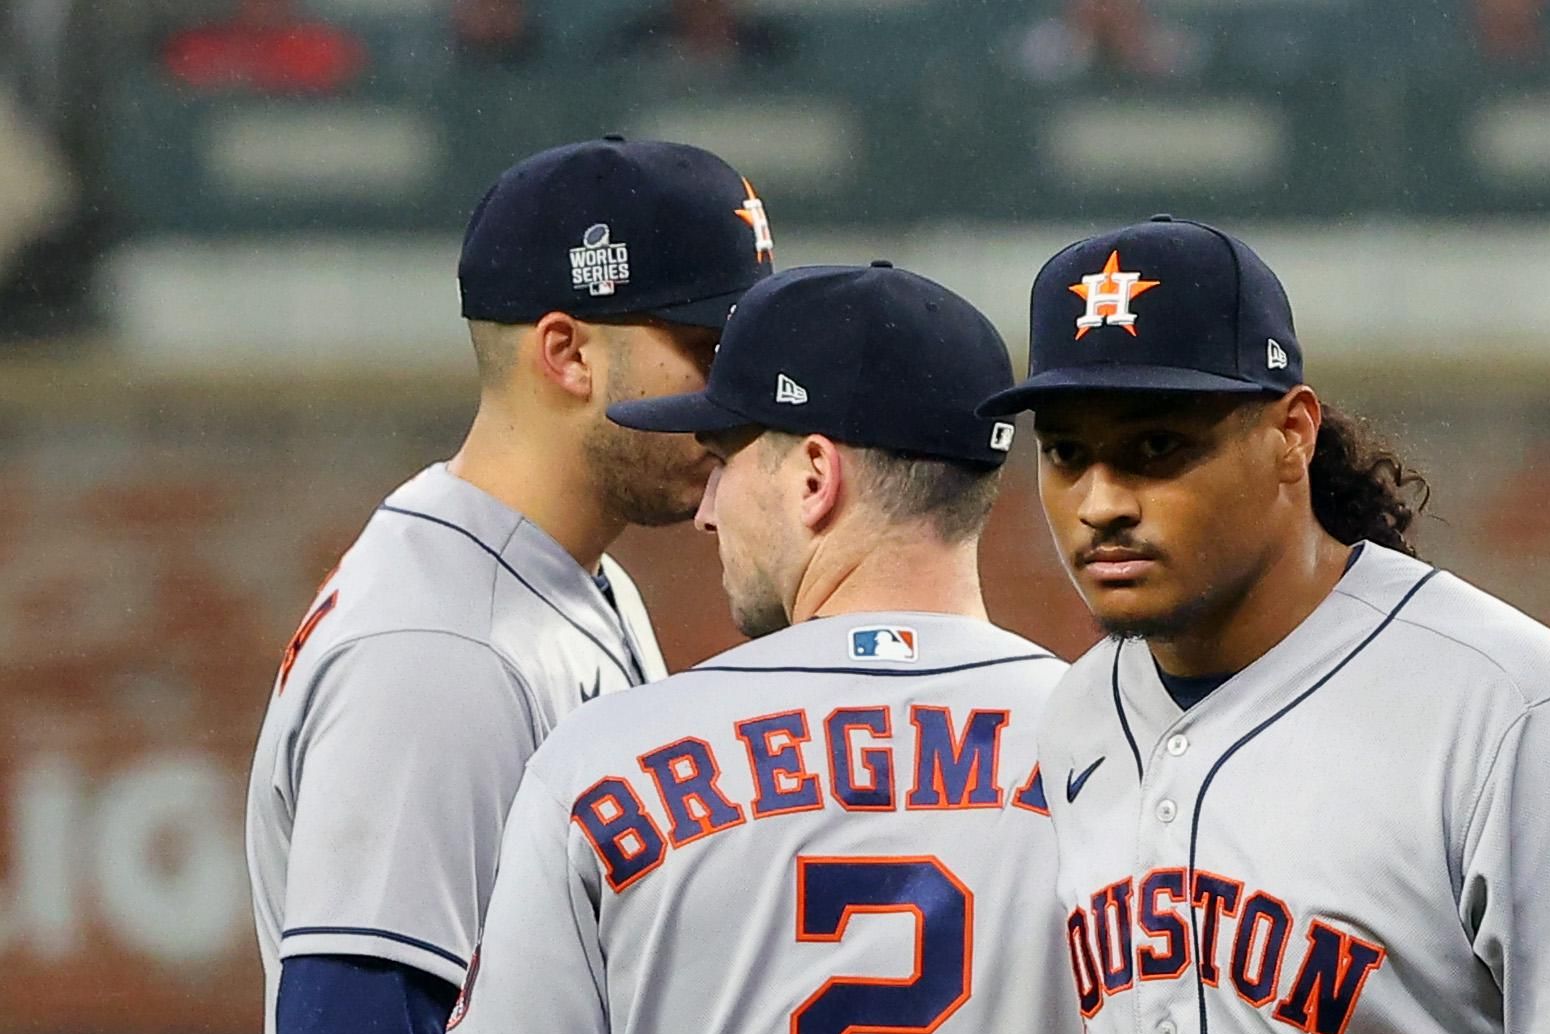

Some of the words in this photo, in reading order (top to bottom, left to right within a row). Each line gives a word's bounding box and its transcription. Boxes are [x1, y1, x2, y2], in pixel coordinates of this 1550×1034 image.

[569, 247, 628, 268] WORLD
[572, 263, 629, 284] SERIES
[1075, 272, 1141, 328] H
